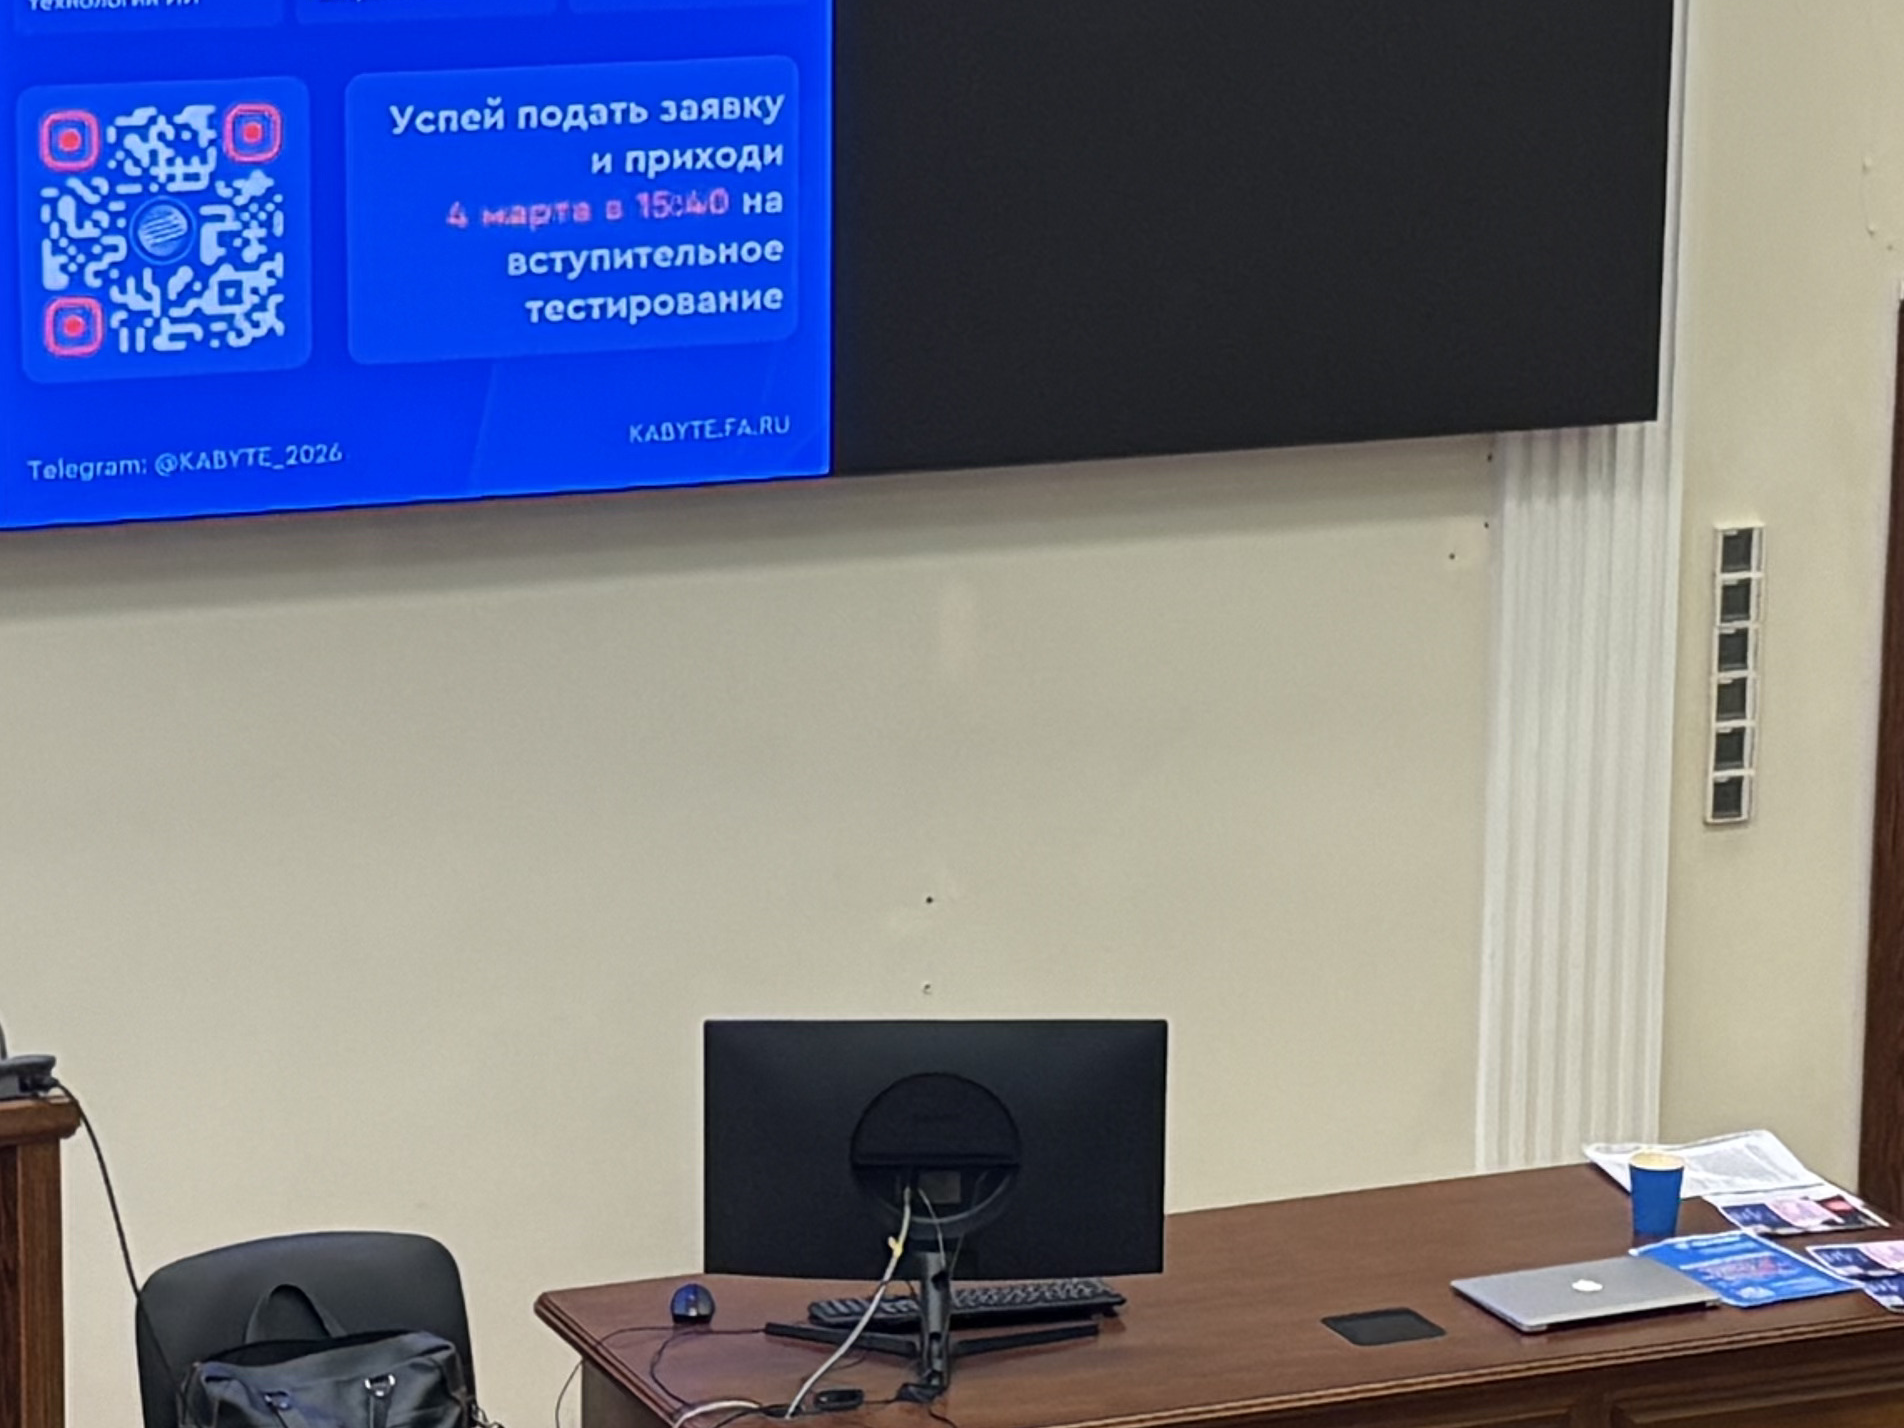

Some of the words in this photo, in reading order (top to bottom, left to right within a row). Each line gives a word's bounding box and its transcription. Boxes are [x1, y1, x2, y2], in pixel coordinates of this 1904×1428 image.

[389, 96, 505, 135] Успей
[517, 101, 649, 133] подать
[659, 94, 785, 125] заявку
[591, 152, 613, 174] и
[625, 143, 784, 180] приходи
[446, 201, 469, 228] 4
[481, 201, 592, 231] марта
[605, 199, 624, 221] в
[636, 187, 730, 219] 15:40
[742, 191, 783, 215] на
[507, 239, 785, 281] вступительное
[524, 287, 784, 325] тестирование
[629, 415, 790, 443] KABYTE.FA.RU
[27, 457, 147, 481] Telegram:
[154, 442, 343, 477] @KABYTE_2026
